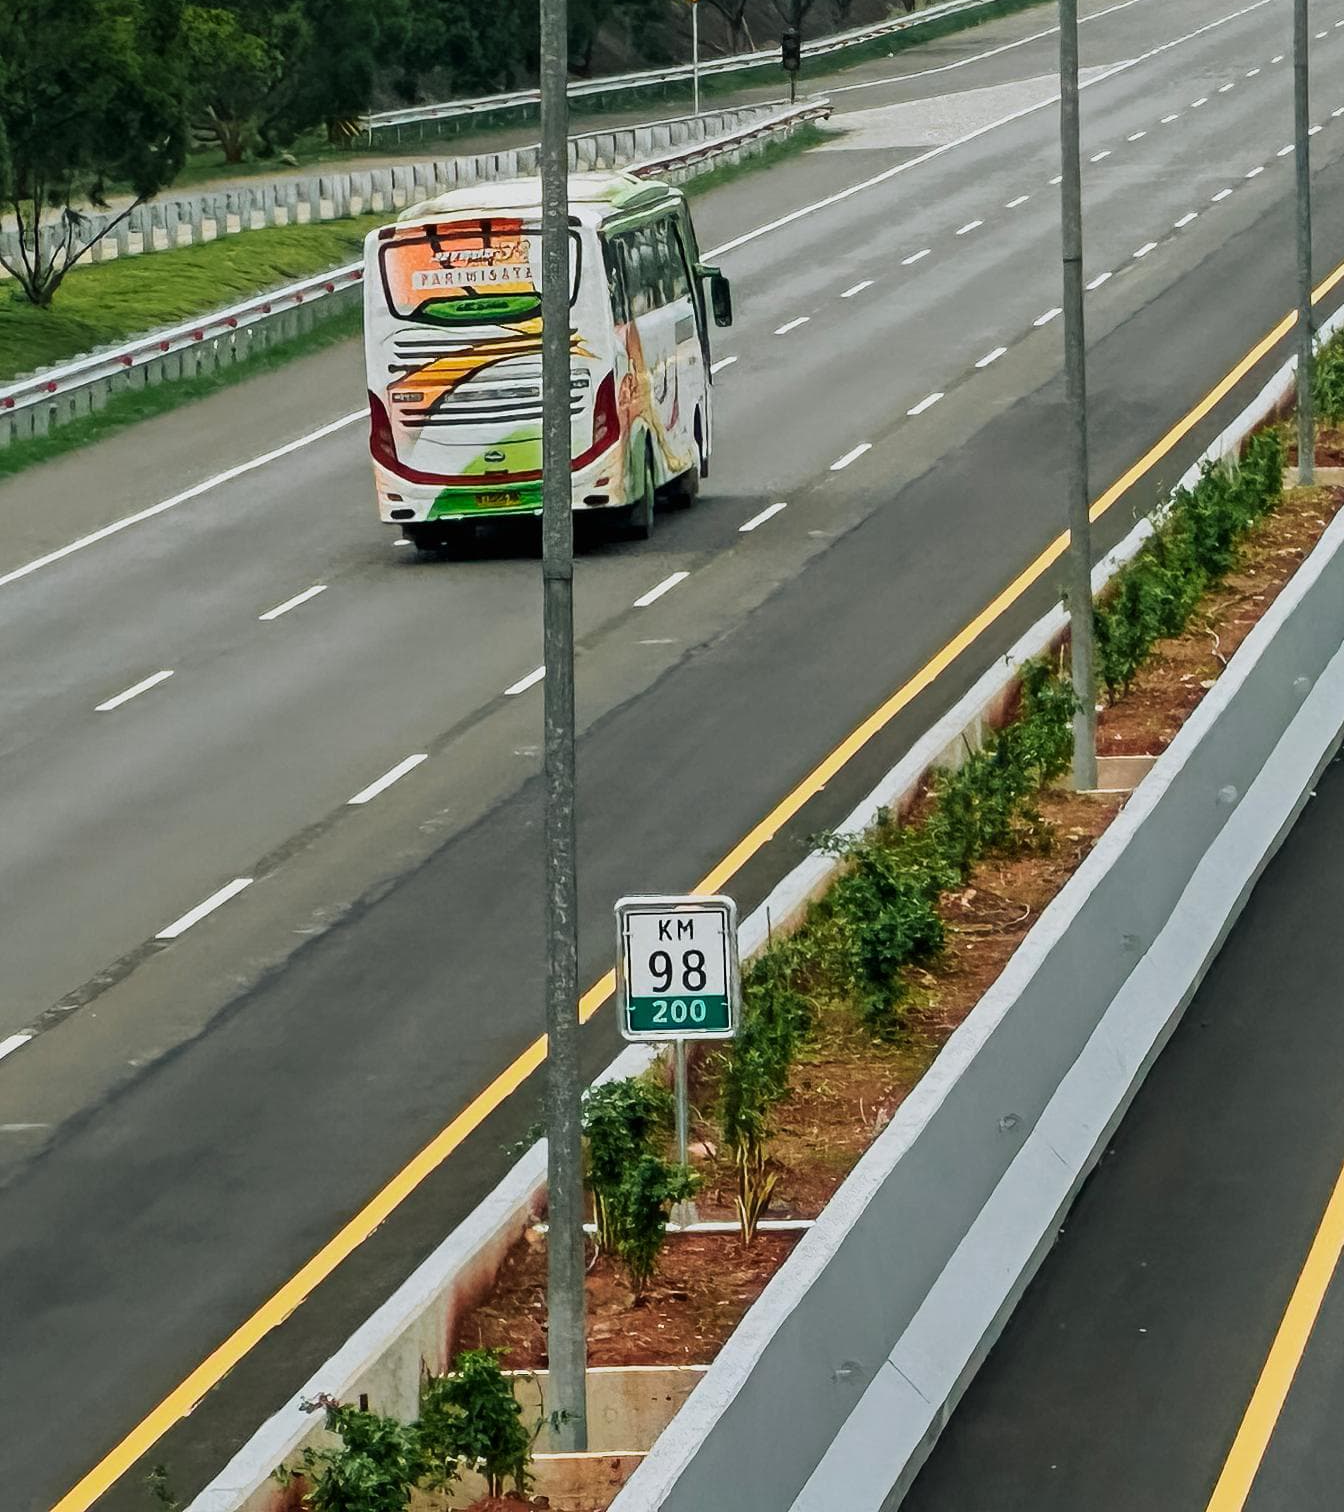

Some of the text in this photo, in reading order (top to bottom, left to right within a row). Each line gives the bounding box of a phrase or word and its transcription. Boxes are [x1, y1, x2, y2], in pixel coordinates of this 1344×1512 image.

[658, 918, 694, 942] KM
[648, 949, 707, 993] 98
[652, 999, 707, 1024] 200
